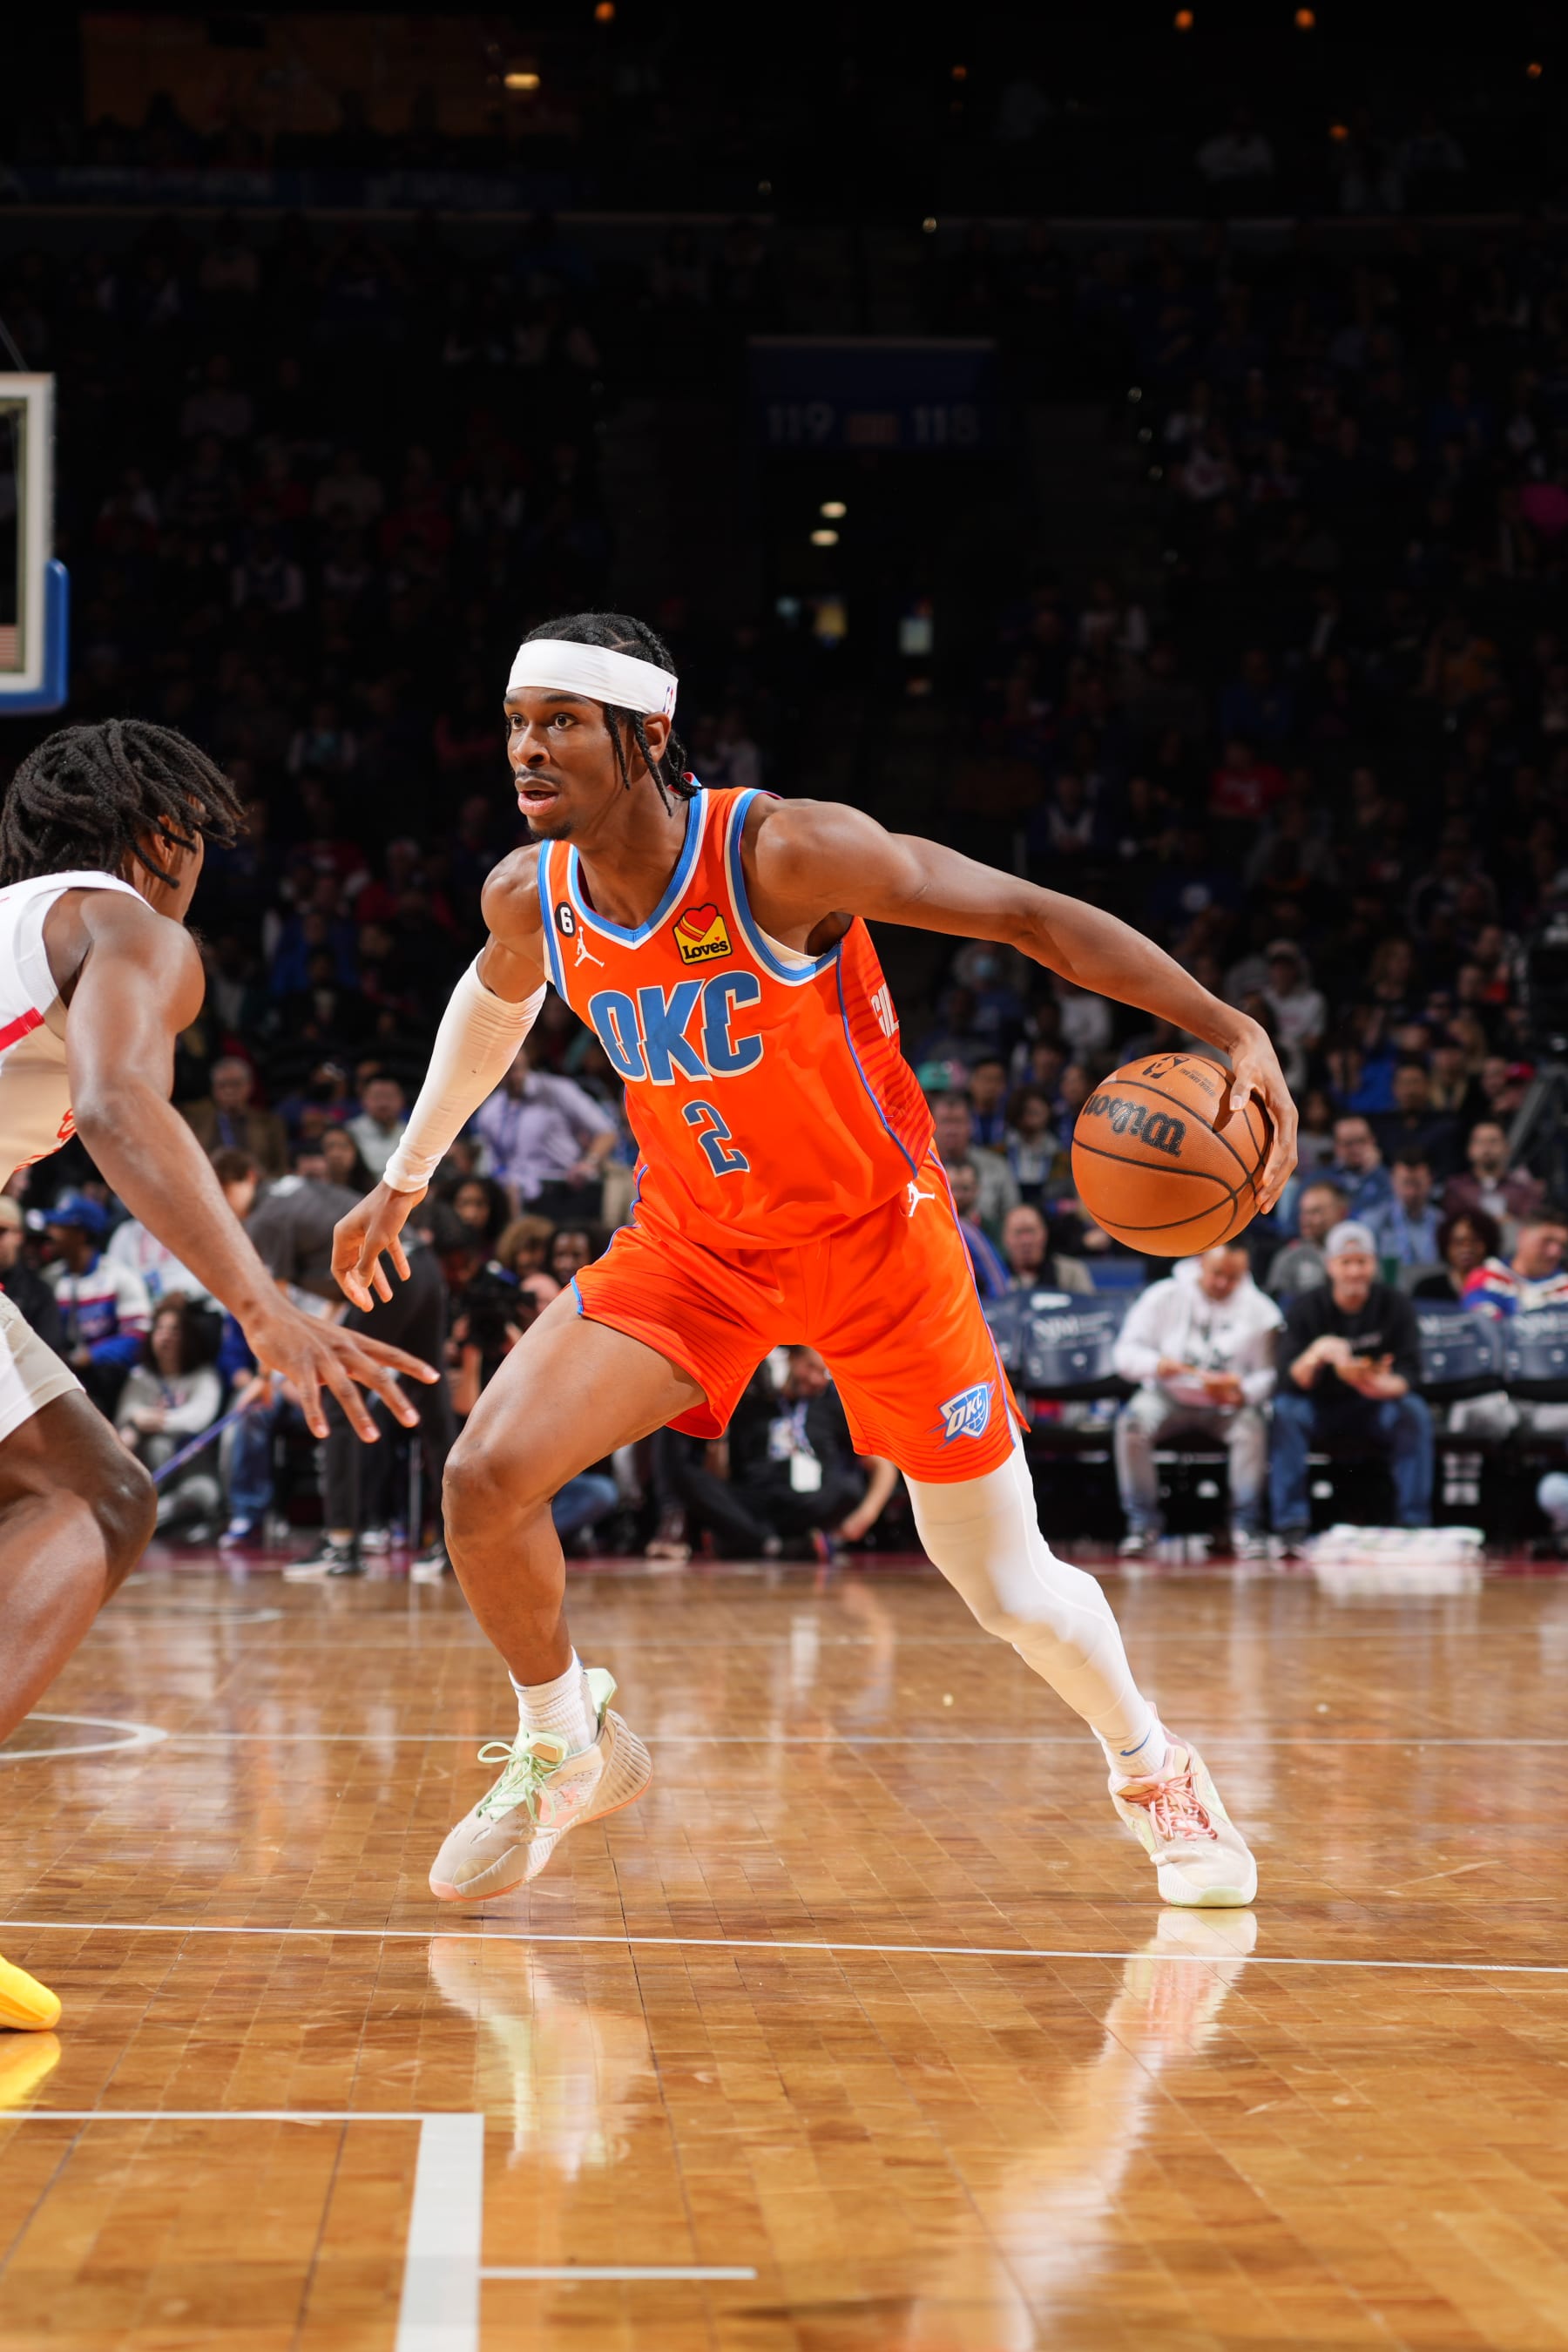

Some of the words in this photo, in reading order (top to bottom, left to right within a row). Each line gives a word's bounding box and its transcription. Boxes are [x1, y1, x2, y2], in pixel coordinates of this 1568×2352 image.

[766, 402, 835, 447] 119
[560, 906, 573, 933] 6
[588, 970, 764, 1085] OKC
[681, 1100, 750, 1178] 2
[1083, 1094, 1186, 1158] Wilson
[946, 1390, 983, 1437] OKC
